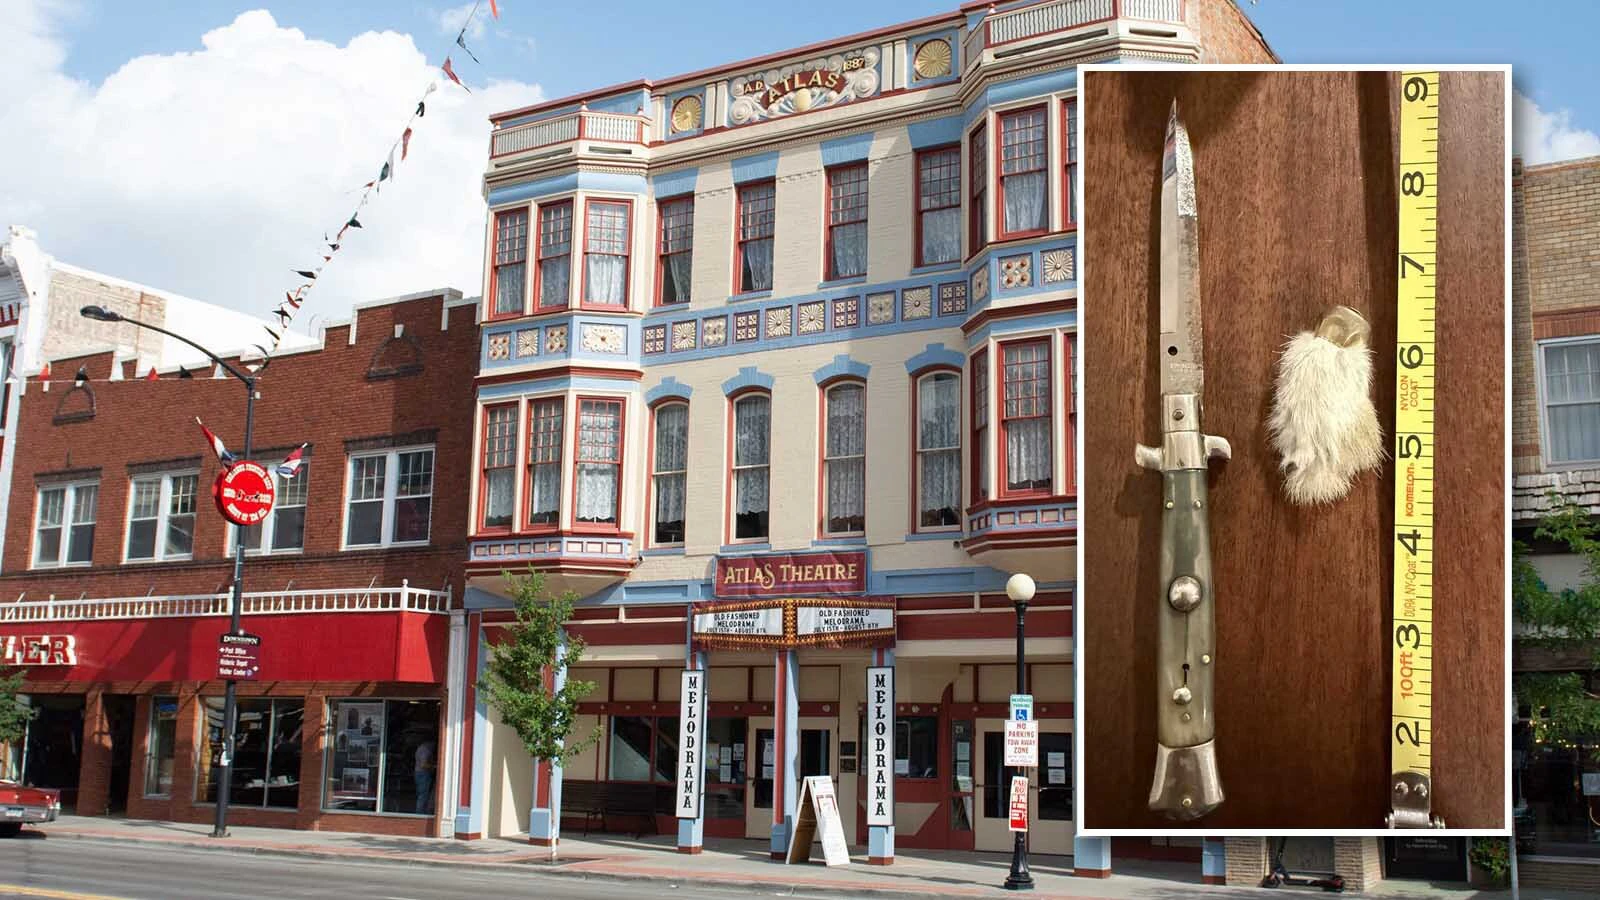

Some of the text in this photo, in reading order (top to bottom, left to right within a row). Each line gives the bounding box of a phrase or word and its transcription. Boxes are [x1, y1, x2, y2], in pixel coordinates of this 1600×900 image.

[843, 57, 865, 71] 1887
[769, 70, 839, 103] ATLAS
[1404, 76, 1428, 102] 9
[1402, 171, 1424, 197] 8
[1401, 255, 1425, 279] 7
[1399, 345, 1423, 369] 6
[1400, 375, 1408, 410] NYLON
[1410, 379, 1418, 407] COAT
[1399, 434, 1421, 460] 5
[1397, 529, 1421, 556] 4
[724, 563, 858, 589] ATLAS THEATRE
[727, 612, 760, 620] FASHIONED
[819, 609, 870, 617] OLD FASHIONED
[824, 617, 865, 625] MELODRAMA
[1396, 623, 1420, 650] 3
[1400, 651, 1413, 699] 100ft
[683, 676, 697, 809] MELODRAMA
[875, 674, 886, 816] MELODRAMA
[1008, 730, 1035, 738] PARKING
[1021, 739, 1036, 747] AWAY
[1396, 721, 1420, 747] 2
